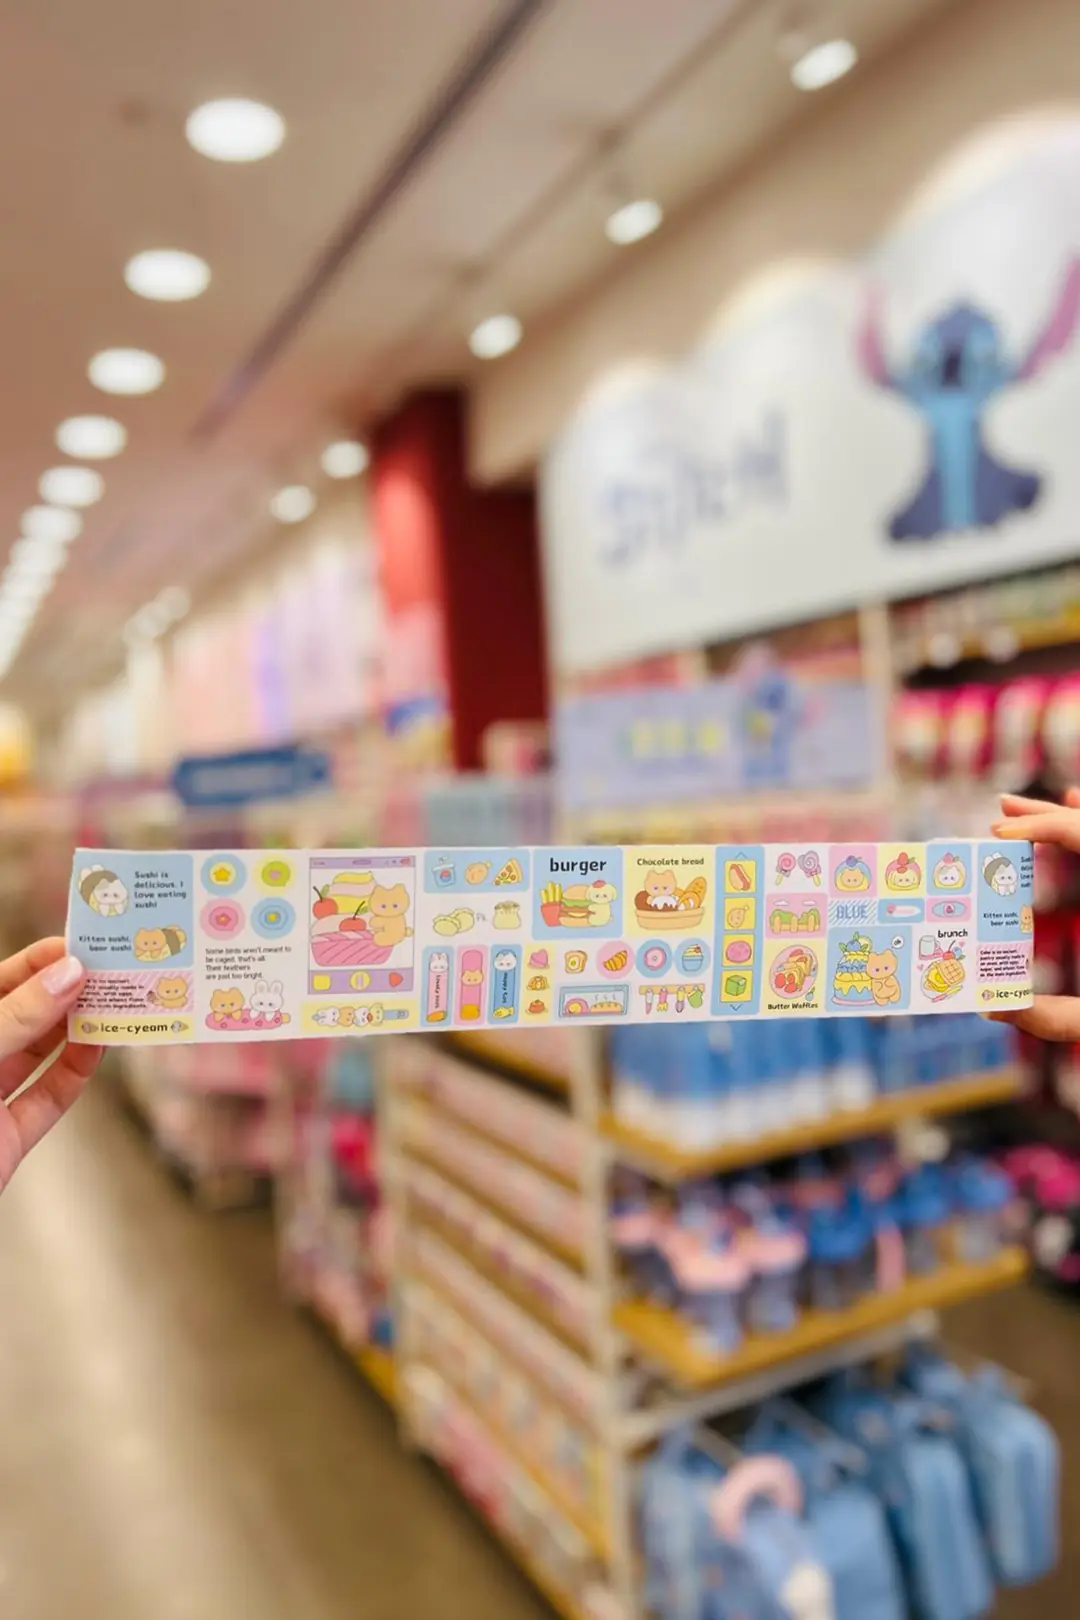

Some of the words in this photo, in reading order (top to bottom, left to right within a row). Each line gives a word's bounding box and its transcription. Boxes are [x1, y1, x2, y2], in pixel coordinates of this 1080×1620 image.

[550, 858, 606, 876] burger
[637, 858, 680, 866] Chocolate
[158, 891, 186, 899] eating
[836, 904, 868, 919] BLUE
[938, 929, 968, 938] brunch
[100, 1022, 168, 1034] ice-cyeam
